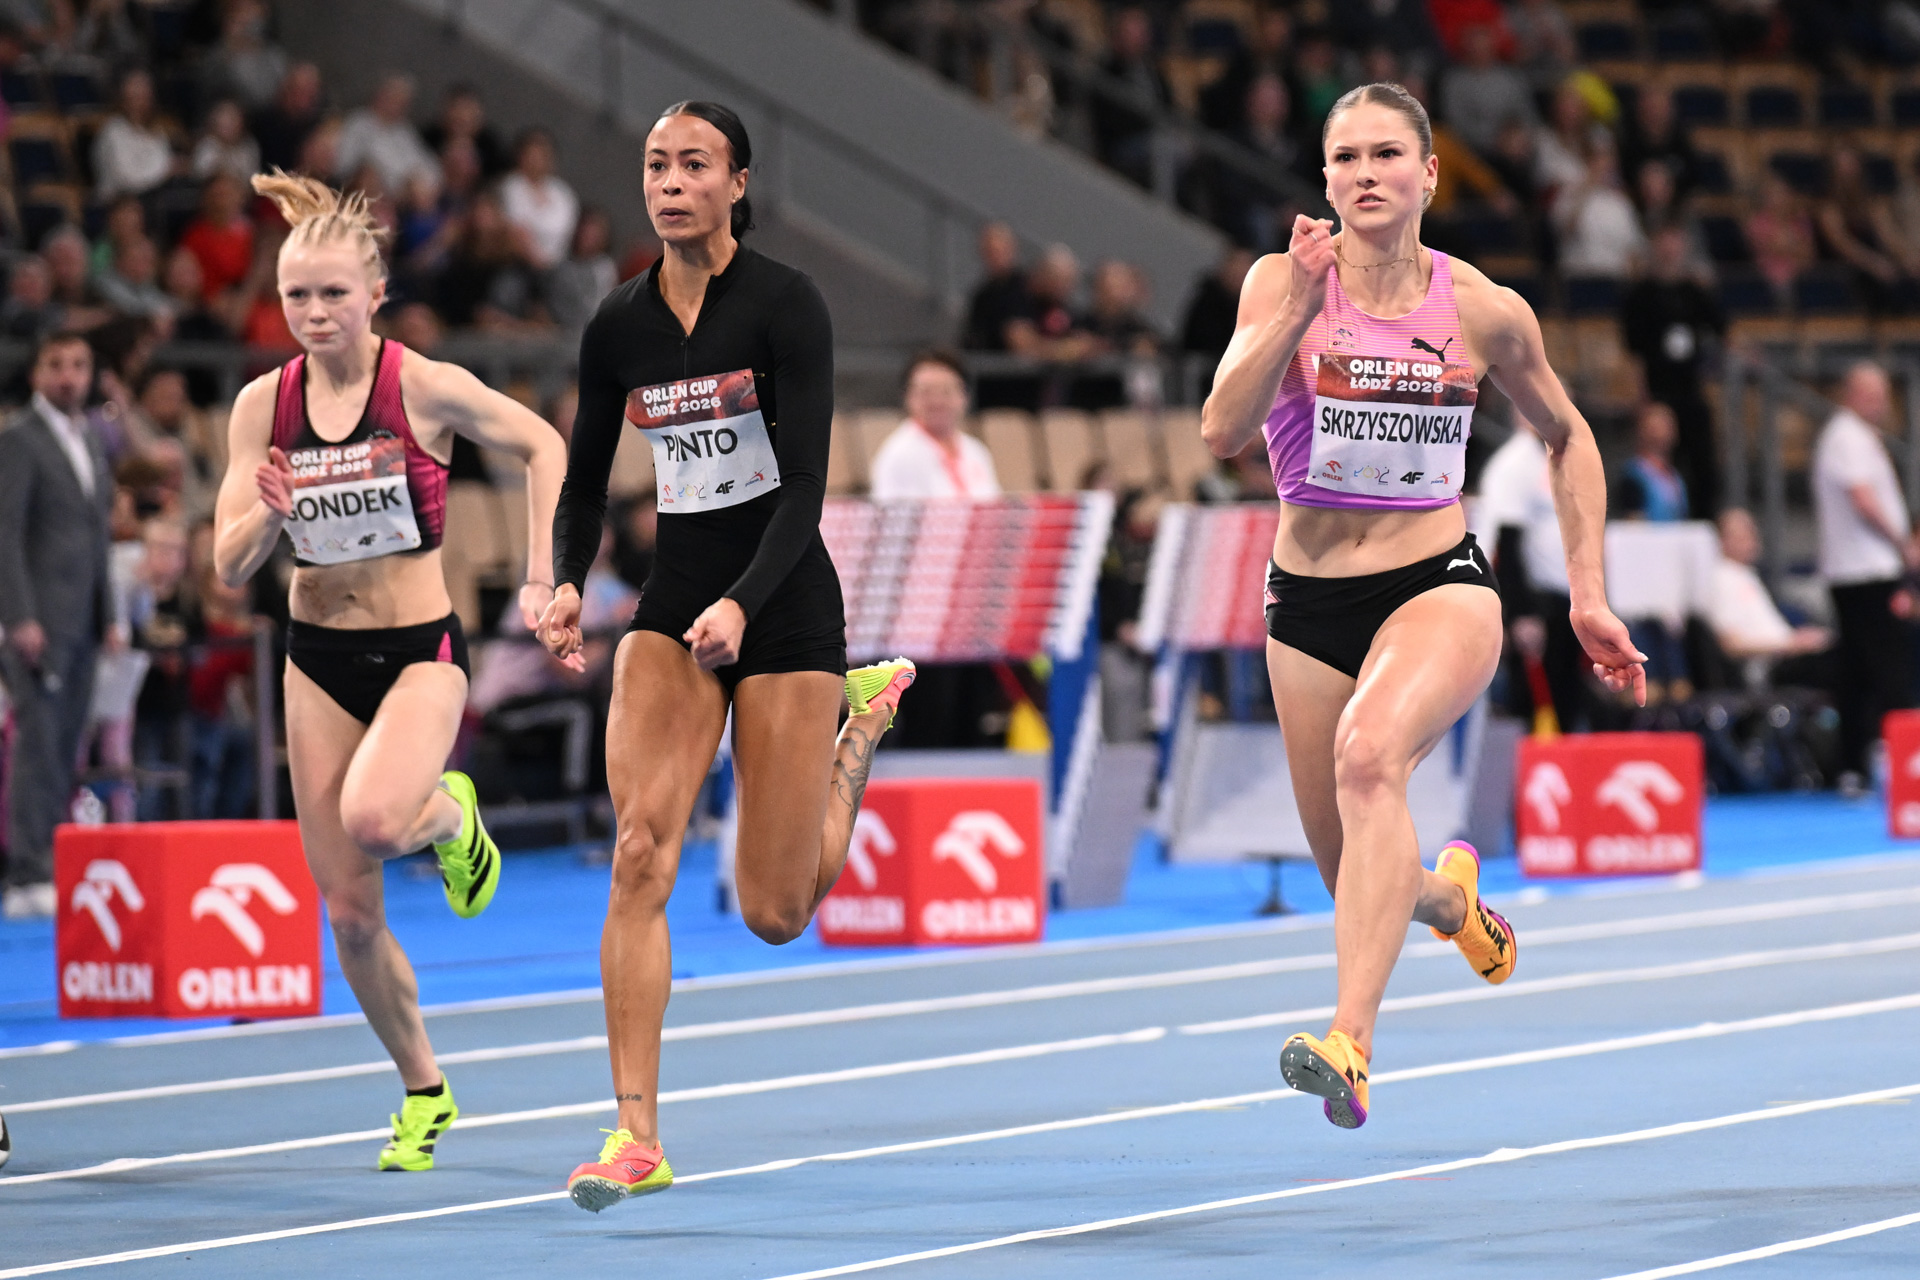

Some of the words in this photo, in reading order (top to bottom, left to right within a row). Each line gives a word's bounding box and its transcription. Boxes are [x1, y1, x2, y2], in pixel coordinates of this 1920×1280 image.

[1350, 359, 1408, 376] ORLEN
[1411, 363, 1443, 379] CUP
[642, 383, 688, 404] ORLEN
[689, 379, 718, 396] CUP
[1350, 375, 1391, 391] ŁÓDŹ
[1396, 380, 1444, 393] 2026
[646, 401, 677, 418] ŁÓDŹ
[680, 396, 722, 413] 2026
[1320, 406, 1462, 444] SKRZYSZOWSKA
[290, 449, 342, 466] ORLEN
[343, 443, 372, 460] CUP
[661, 428, 738, 462] PINTO
[332, 459, 373, 475] 2026
[1322, 472, 1343, 482] ORLEN
[1400, 471, 1425, 484] 4F
[715, 480, 735, 494] 4F
[63, 961, 154, 1002] ORLEN
[178, 964, 312, 1010] ORLEN
